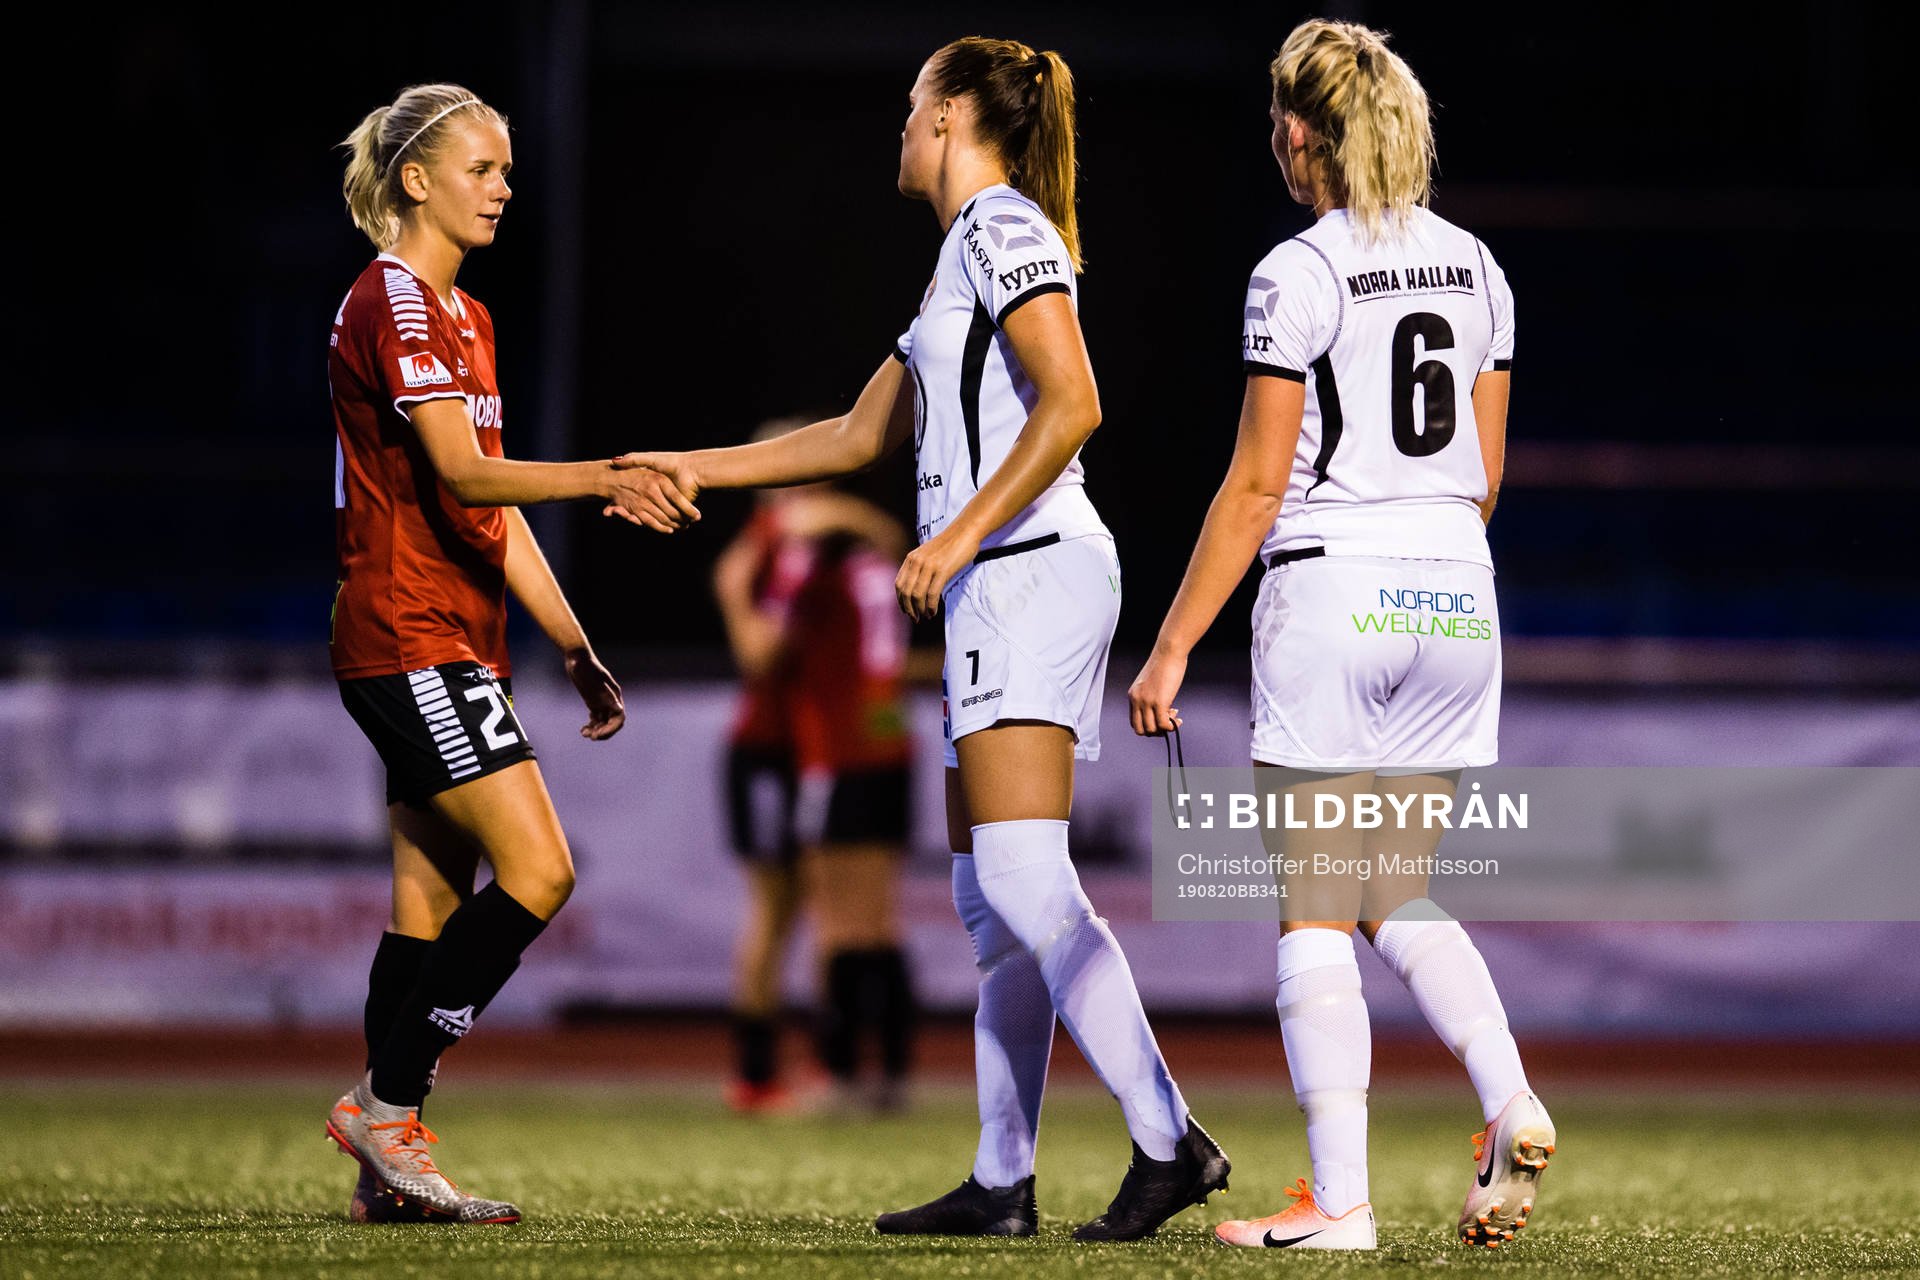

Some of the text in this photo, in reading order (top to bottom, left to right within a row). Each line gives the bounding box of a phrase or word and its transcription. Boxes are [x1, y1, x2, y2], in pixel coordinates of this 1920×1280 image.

[963, 227, 994, 281] RASTA
[998, 260, 1059, 291] typIT
[1346, 269, 1401, 298] NORRA
[1405, 266, 1474, 290] HALLAND
[406, 376, 450, 387] SVENSKA SPEL
[1391, 312, 1456, 458] 6
[1379, 588, 1475, 614] NORDIC
[1351, 613, 1492, 640] WELLNESS
